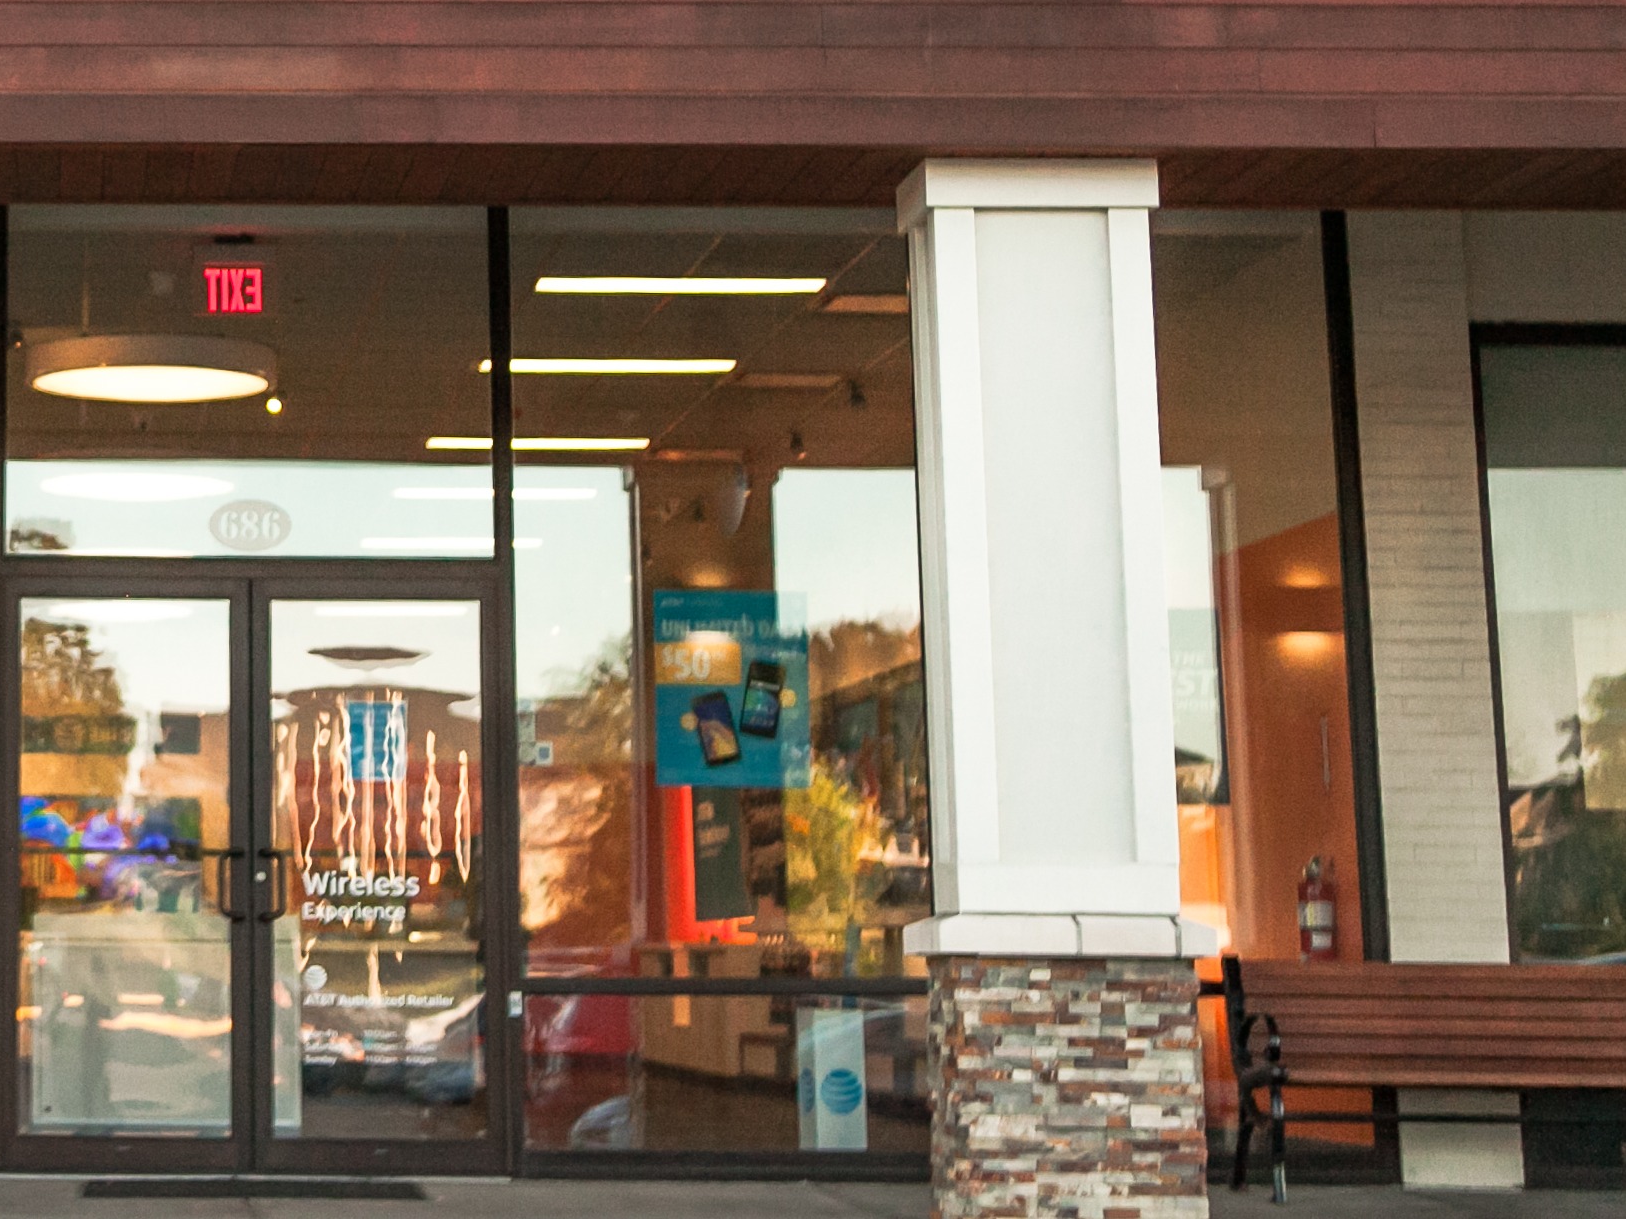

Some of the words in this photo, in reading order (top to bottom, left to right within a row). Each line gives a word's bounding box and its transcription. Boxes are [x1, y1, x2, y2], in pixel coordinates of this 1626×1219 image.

[220, 510, 281, 541] 686
[302, 870, 421, 897] Wireless
[301, 901, 407, 925] Experience
[337, 993, 405, 1007] Authoized
